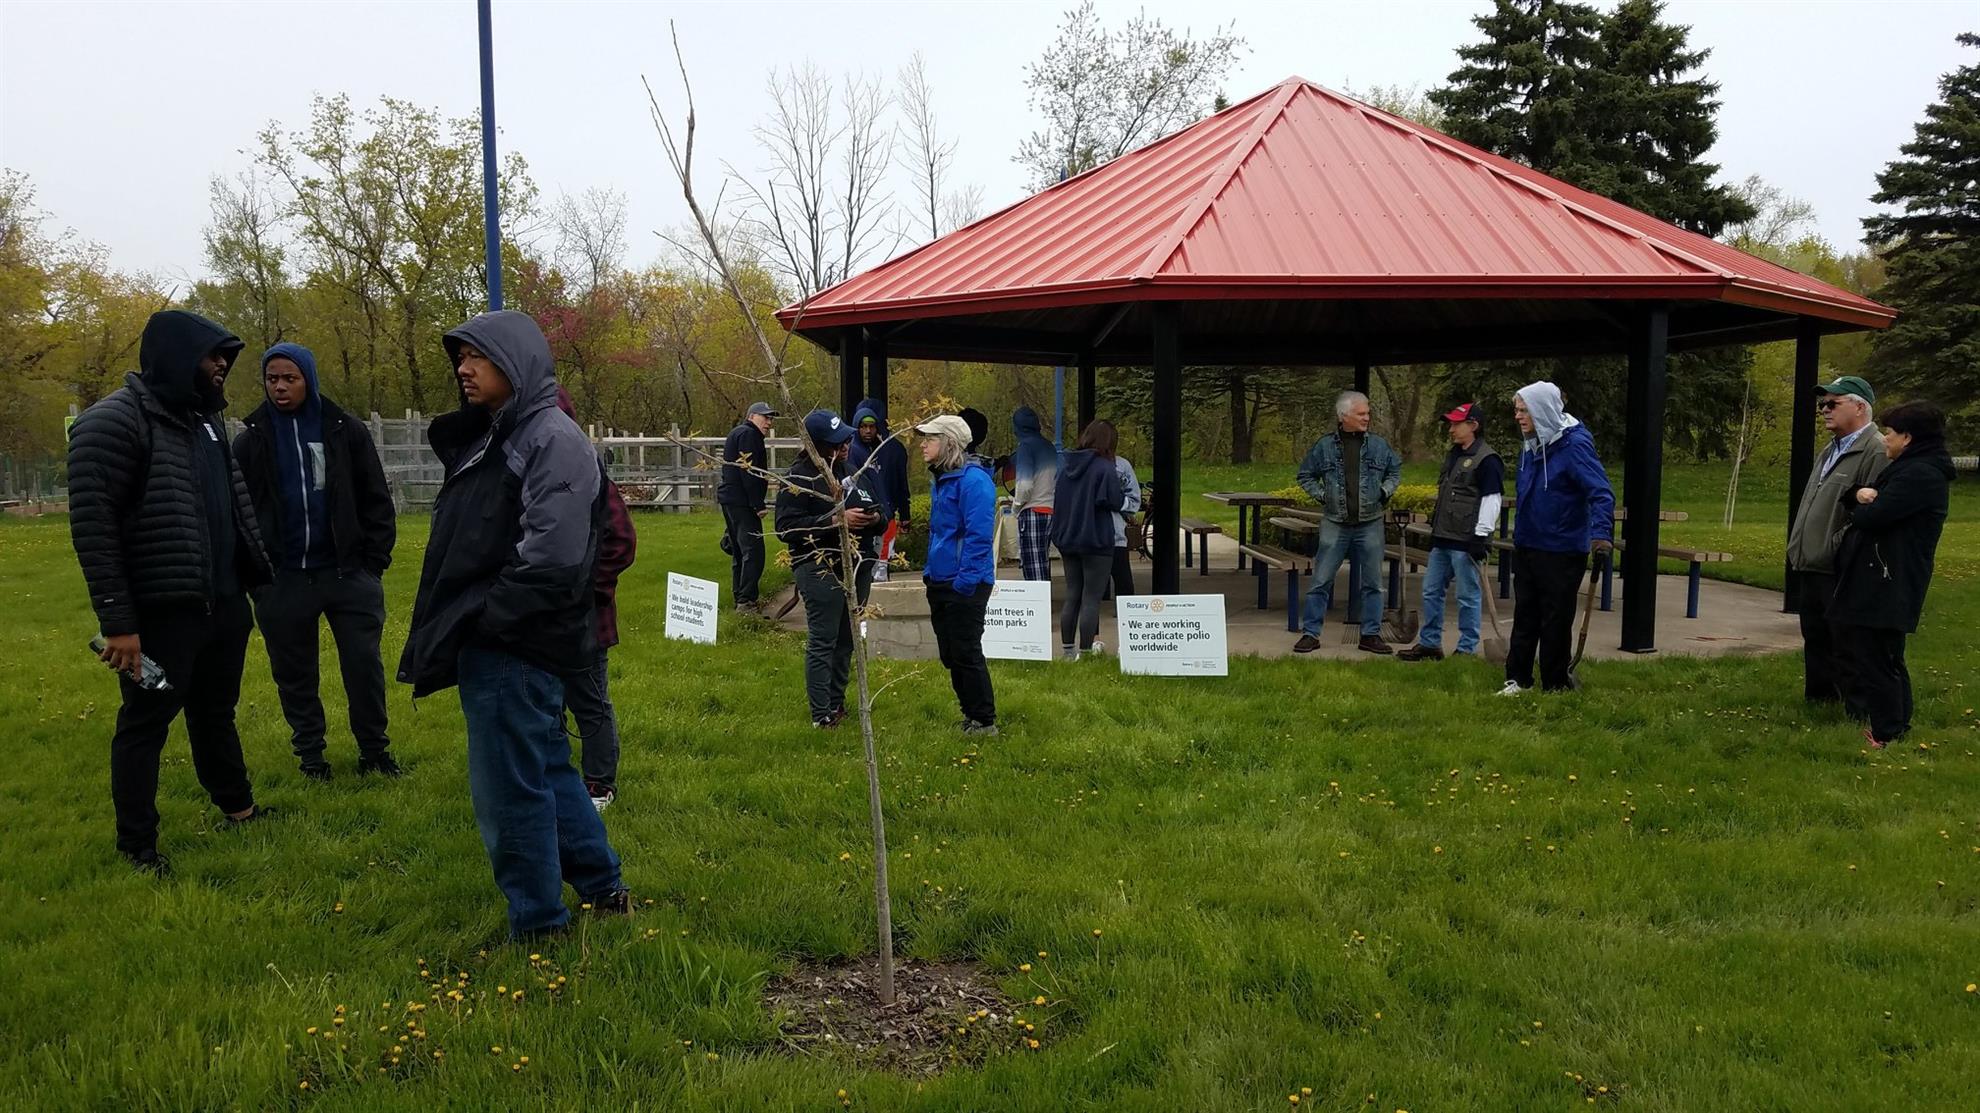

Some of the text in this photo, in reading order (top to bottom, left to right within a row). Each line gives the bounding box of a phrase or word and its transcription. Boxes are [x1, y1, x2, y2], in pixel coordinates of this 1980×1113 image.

[690, 598, 713, 611] leadership
[671, 603, 685, 613] camps
[693, 608, 703, 619] high
[1004, 608, 1024, 616] trees
[1026, 608, 1034, 616] in
[670, 612, 685, 621] school
[1005, 618, 1027, 628] parks
[1128, 620, 1142, 629] We
[1162, 620, 1200, 630] working
[1129, 630, 1210, 642] to eradicate polio
[1129, 642, 1178, 652] worldwide
